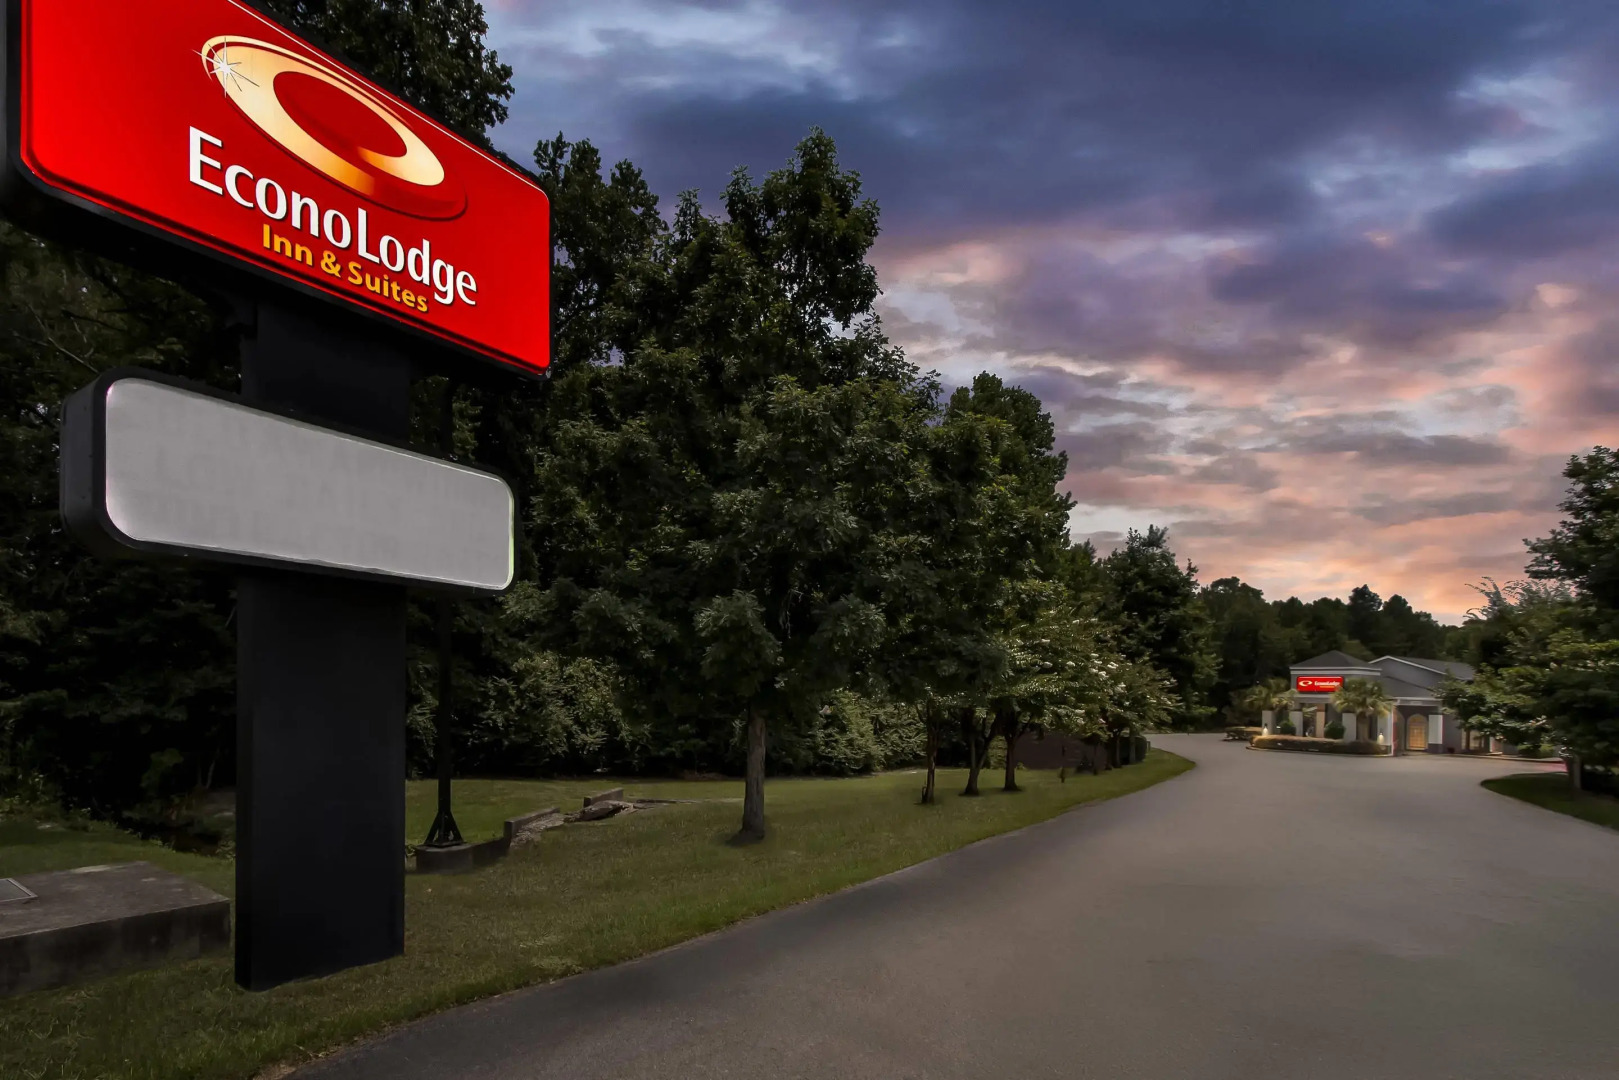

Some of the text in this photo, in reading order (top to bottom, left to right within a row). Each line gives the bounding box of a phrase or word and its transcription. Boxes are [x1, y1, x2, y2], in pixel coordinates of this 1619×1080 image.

[263, 223, 428, 312] Inn & Suites
